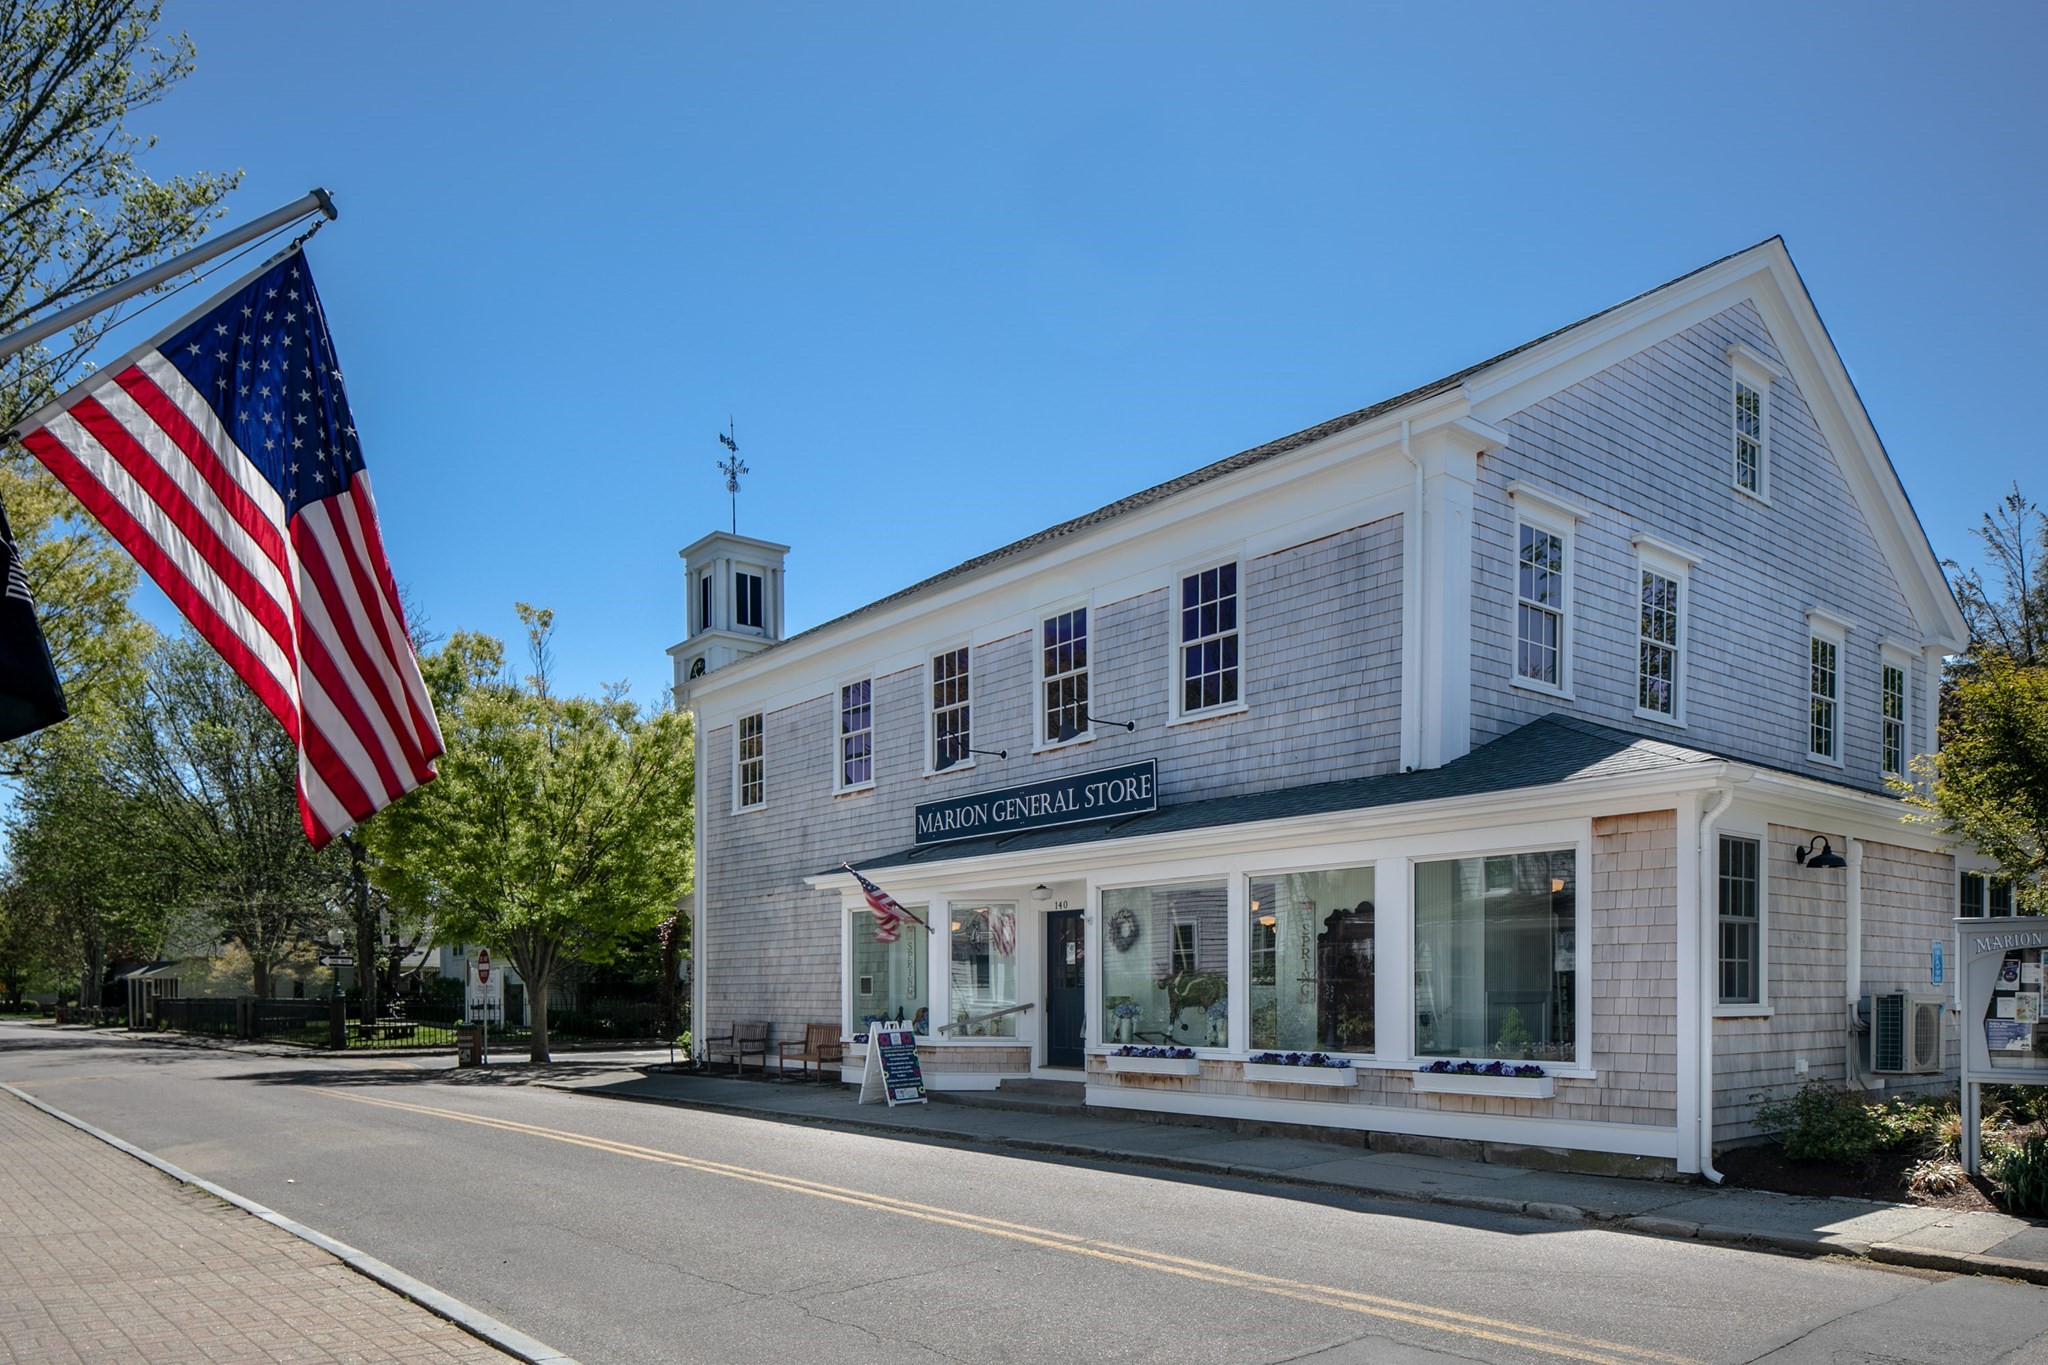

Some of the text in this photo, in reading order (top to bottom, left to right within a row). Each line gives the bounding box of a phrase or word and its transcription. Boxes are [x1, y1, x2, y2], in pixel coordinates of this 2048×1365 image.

[917, 774, 1152, 834] MARION GENERAL STORE
[1055, 900, 1068, 910] 140
[1301, 924, 1310, 996] SPRING
[1975, 932, 2043, 954] MARION
